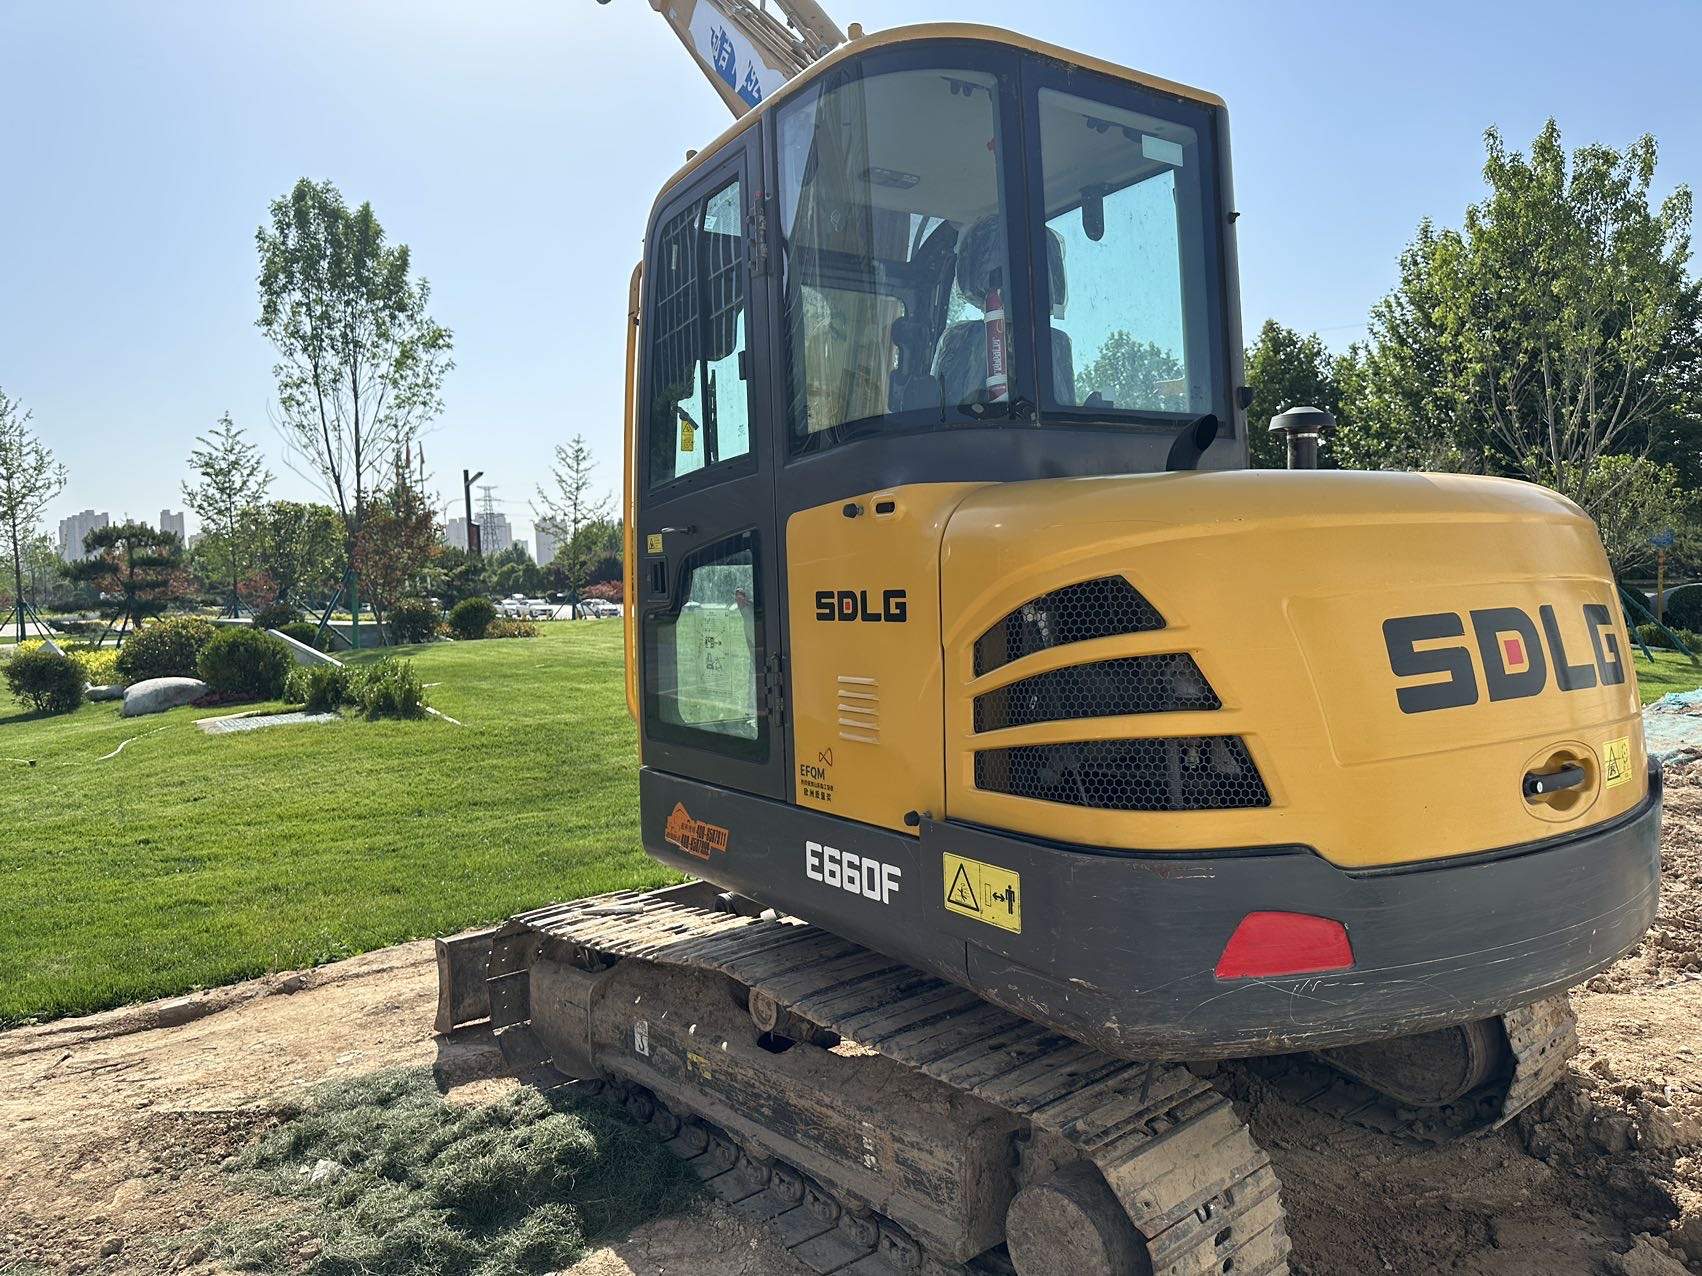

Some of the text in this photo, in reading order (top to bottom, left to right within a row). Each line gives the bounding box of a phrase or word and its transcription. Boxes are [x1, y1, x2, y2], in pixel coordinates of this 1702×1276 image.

[815, 589, 907, 622] SDLG
[1382, 604, 1625, 714] SDLG
[800, 764, 825, 780] EFQM
[805, 840, 901, 904] E660F
